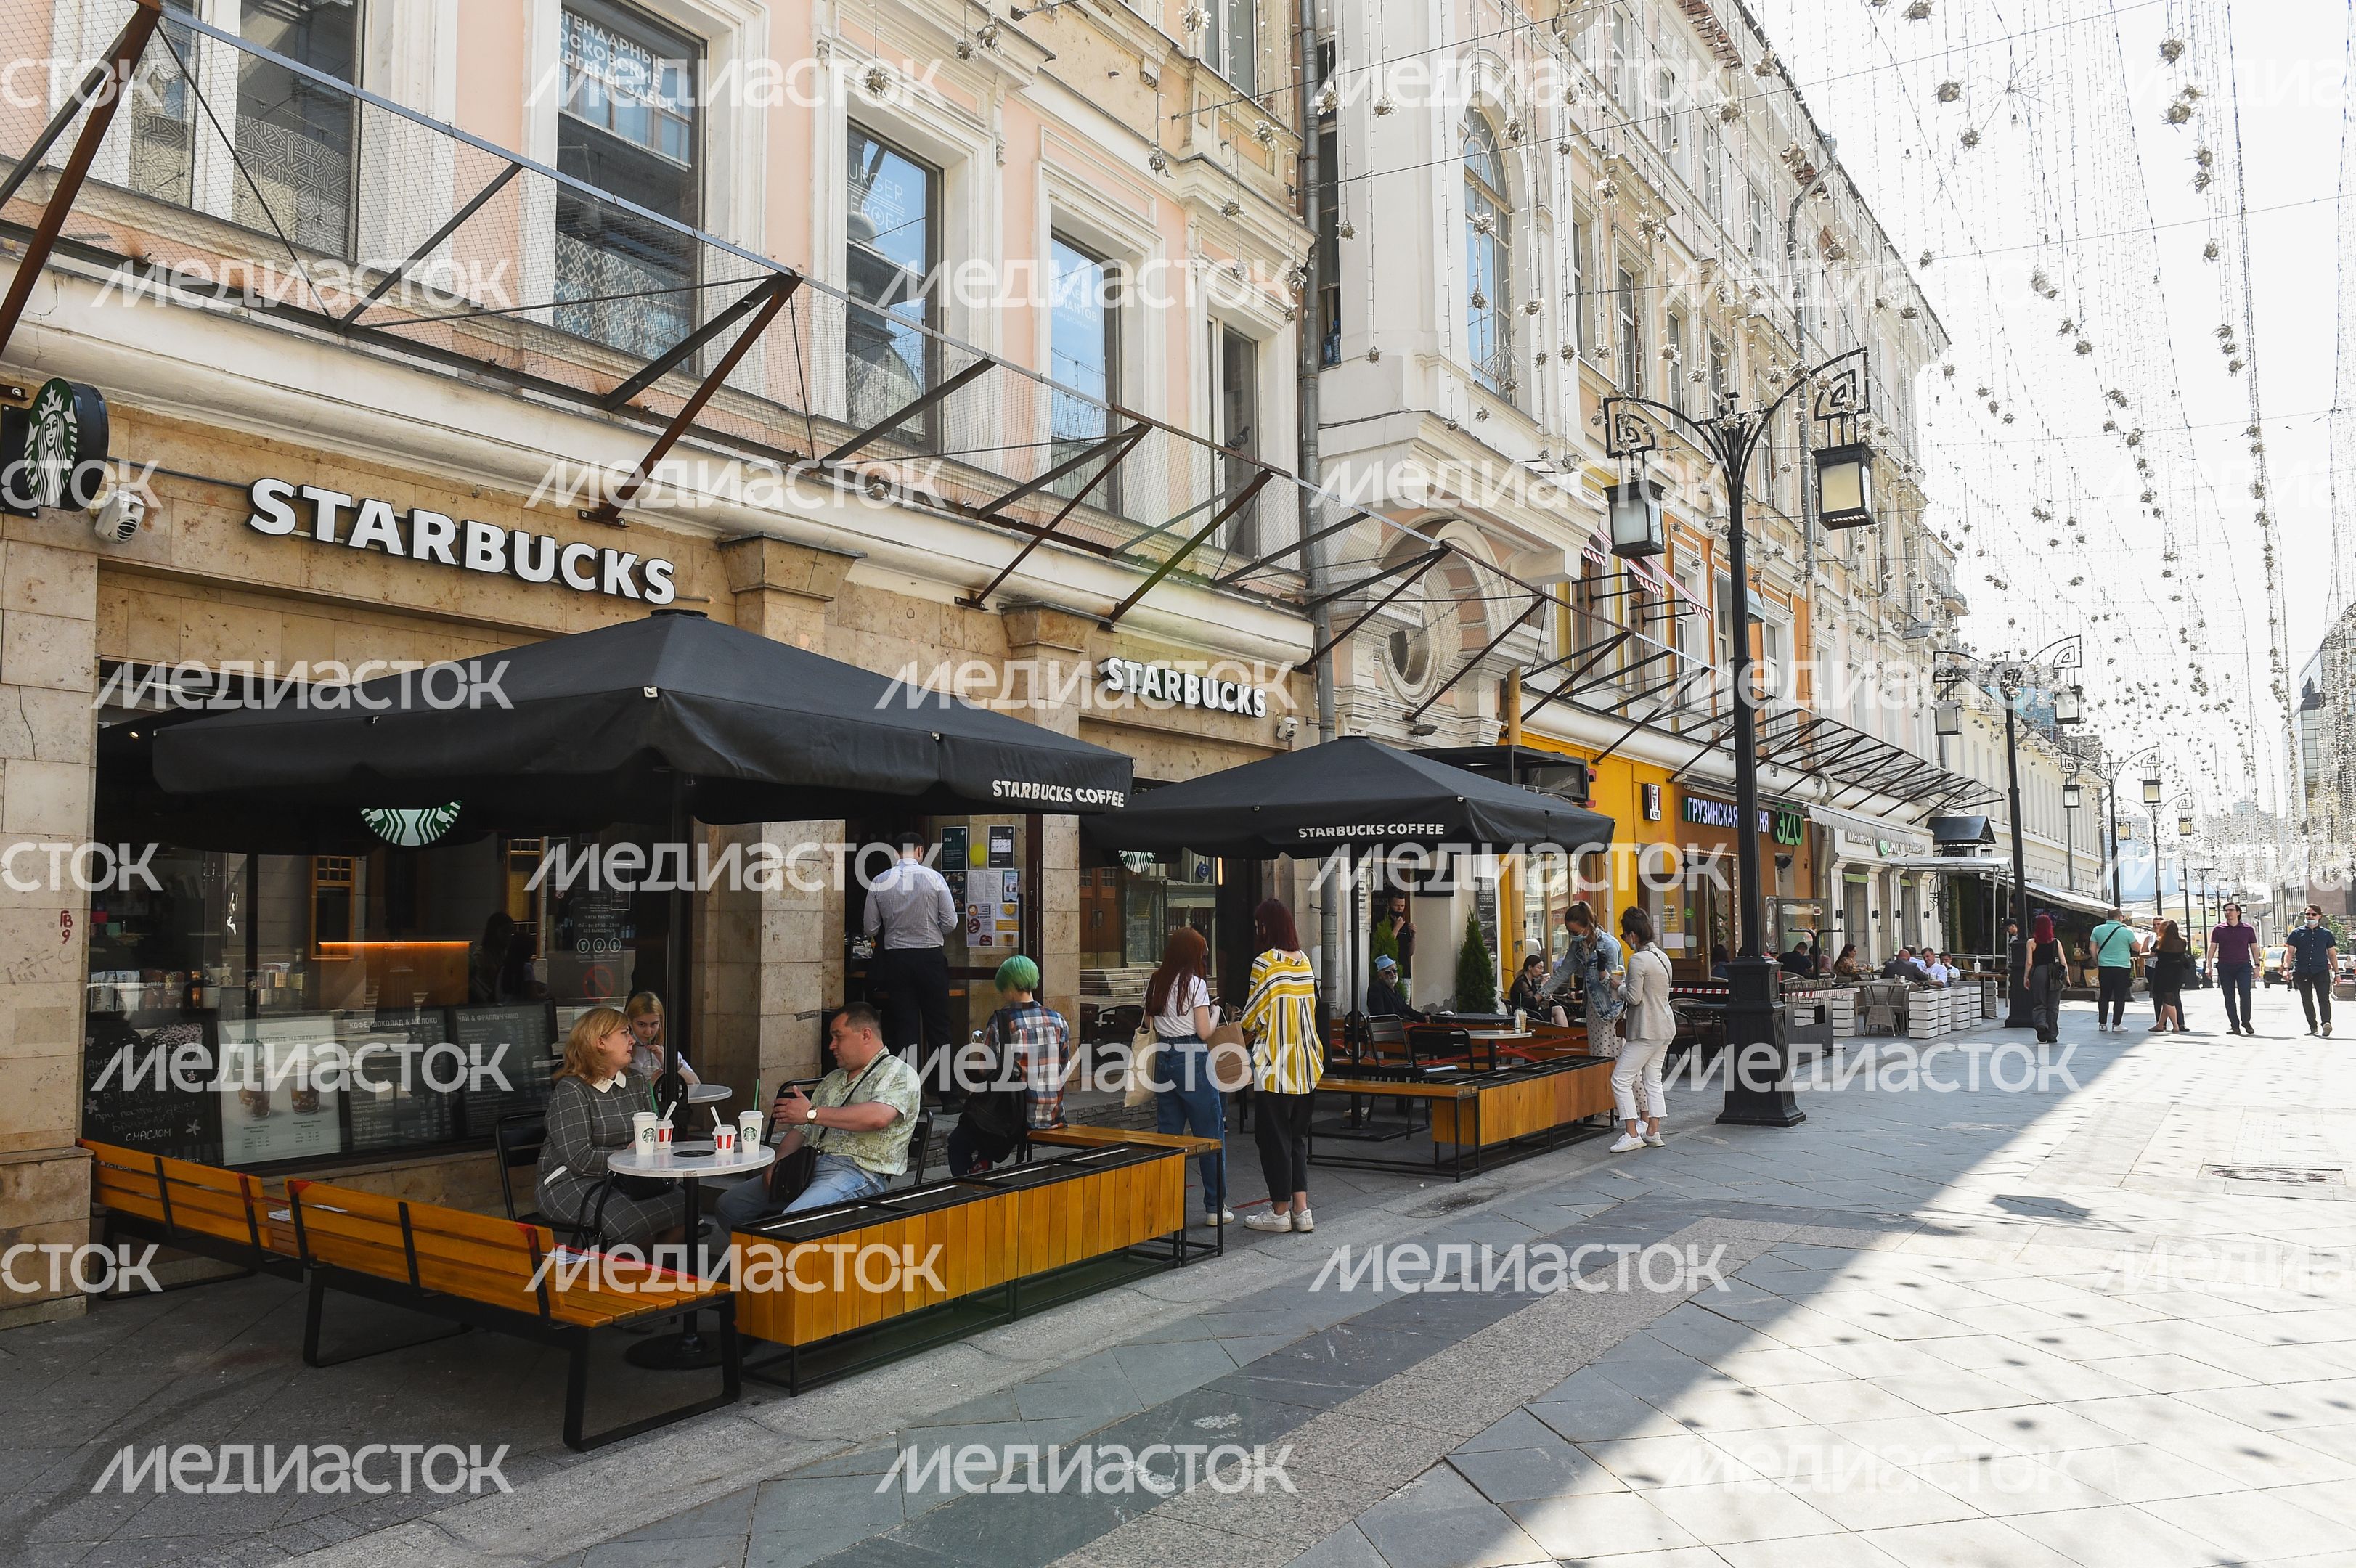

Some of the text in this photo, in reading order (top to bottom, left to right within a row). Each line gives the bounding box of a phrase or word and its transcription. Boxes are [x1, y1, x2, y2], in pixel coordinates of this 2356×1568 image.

[626, 78, 677, 113] ЗДЕСЬ
[249, 476, 675, 605] STARBUCKS
[1106, 657, 1267, 719] STARBUCKS
[992, 779, 1125, 808] STARBUCKS COFFEE
[1687, 797, 1738, 828] ГРУЗИНСКАЯ
[1298, 822, 1444, 838] STARBUCKS COFFEE
